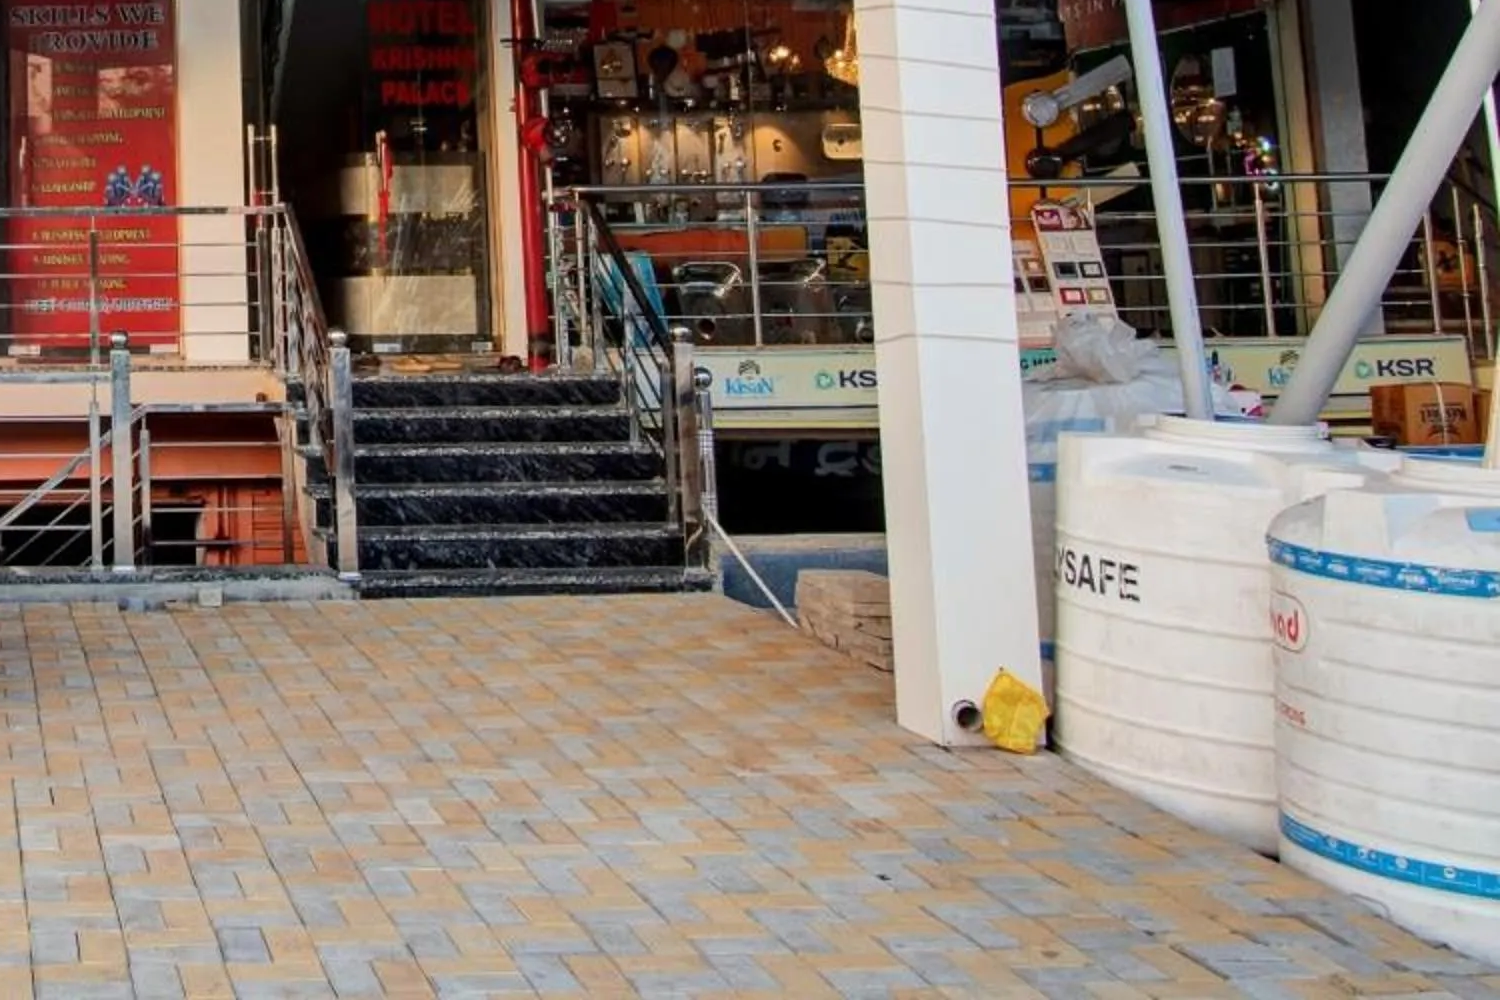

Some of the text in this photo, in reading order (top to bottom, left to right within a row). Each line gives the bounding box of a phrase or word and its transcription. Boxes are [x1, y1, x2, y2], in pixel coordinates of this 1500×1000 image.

[9, 2, 165, 27] SKILLS WE
[1376, 358, 1436, 377] KSR
[838, 370, 878, 388] KS
